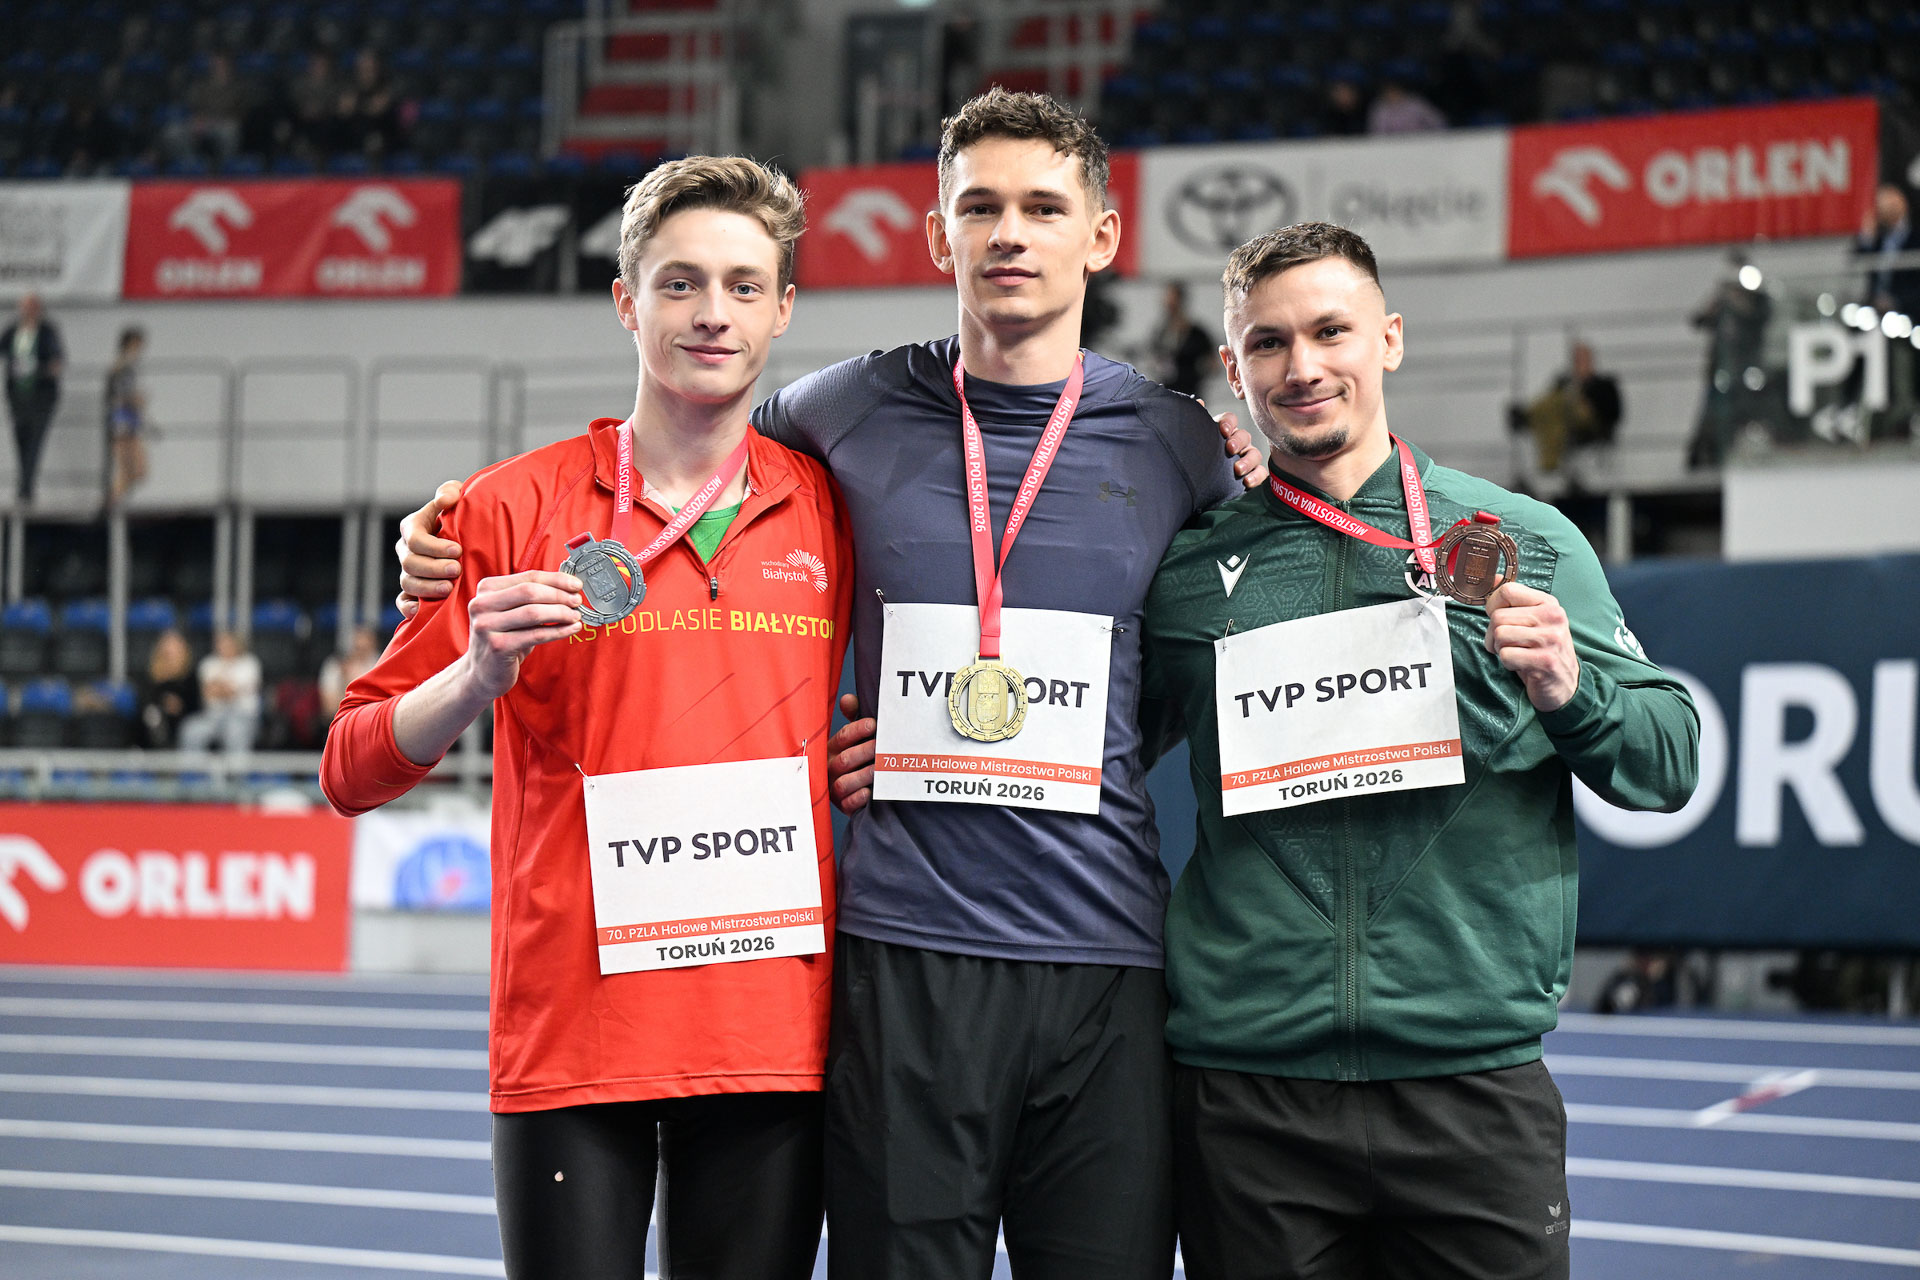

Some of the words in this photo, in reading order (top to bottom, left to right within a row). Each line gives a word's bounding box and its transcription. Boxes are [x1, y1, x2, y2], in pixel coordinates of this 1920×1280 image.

[1645, 138, 1849, 206] ORLEN
[1034, 397, 1074, 468] MISTRZOSTWA
[617, 449, 630, 513] MISTRZOSTWA
[970, 461, 983, 502] POLSKI
[1017, 469, 1042, 507] POLSKI
[1405, 464, 1425, 528] MISTRZOSTWA
[672, 475, 723, 529] MISTRZOSTWA
[974, 505, 987, 533] 2026
[1007, 508, 1024, 534] 2026
[1300, 498, 1369, 536] MISTRZOSTWA
[649, 527, 678, 551] POLSKI
[762, 568, 809, 583] Białystok
[1235, 682, 1305, 718] TVP
[1315, 662, 1432, 703] SPORT
[883, 757, 900, 769] 70.
[902, 757, 929, 769] PZLA
[931, 758, 978, 771] Halowe
[980, 760, 1055, 777] Mistrzostwa
[1057, 767, 1092, 781] Polski
[1231, 775, 1249, 786] 70.
[1252, 769, 1281, 782] PZLA
[1284, 758, 1330, 777] Halowe
[1333, 749, 1410, 767] Mistrzostwa
[1413, 742, 1451, 757] Polski
[924, 778, 992, 797] TORUŃ
[997, 783, 1045, 801] 2026
[1278, 773, 1348, 801] TORUŃ
[1353, 769, 1404, 788] 2026
[608, 836, 682, 868] TVP
[691, 825, 797, 860] SPORT
[81, 849, 316, 920] ORLEN
[607, 929, 626, 941] 70.
[629, 927, 658, 939] PZLA
[661, 922, 708, 936] Halowe
[711, 916, 781, 931] Mistrzostwa
[783, 910, 814, 924] Polski
[657, 937, 725, 961] TORUŃ
[730, 936, 775, 954] 2026
